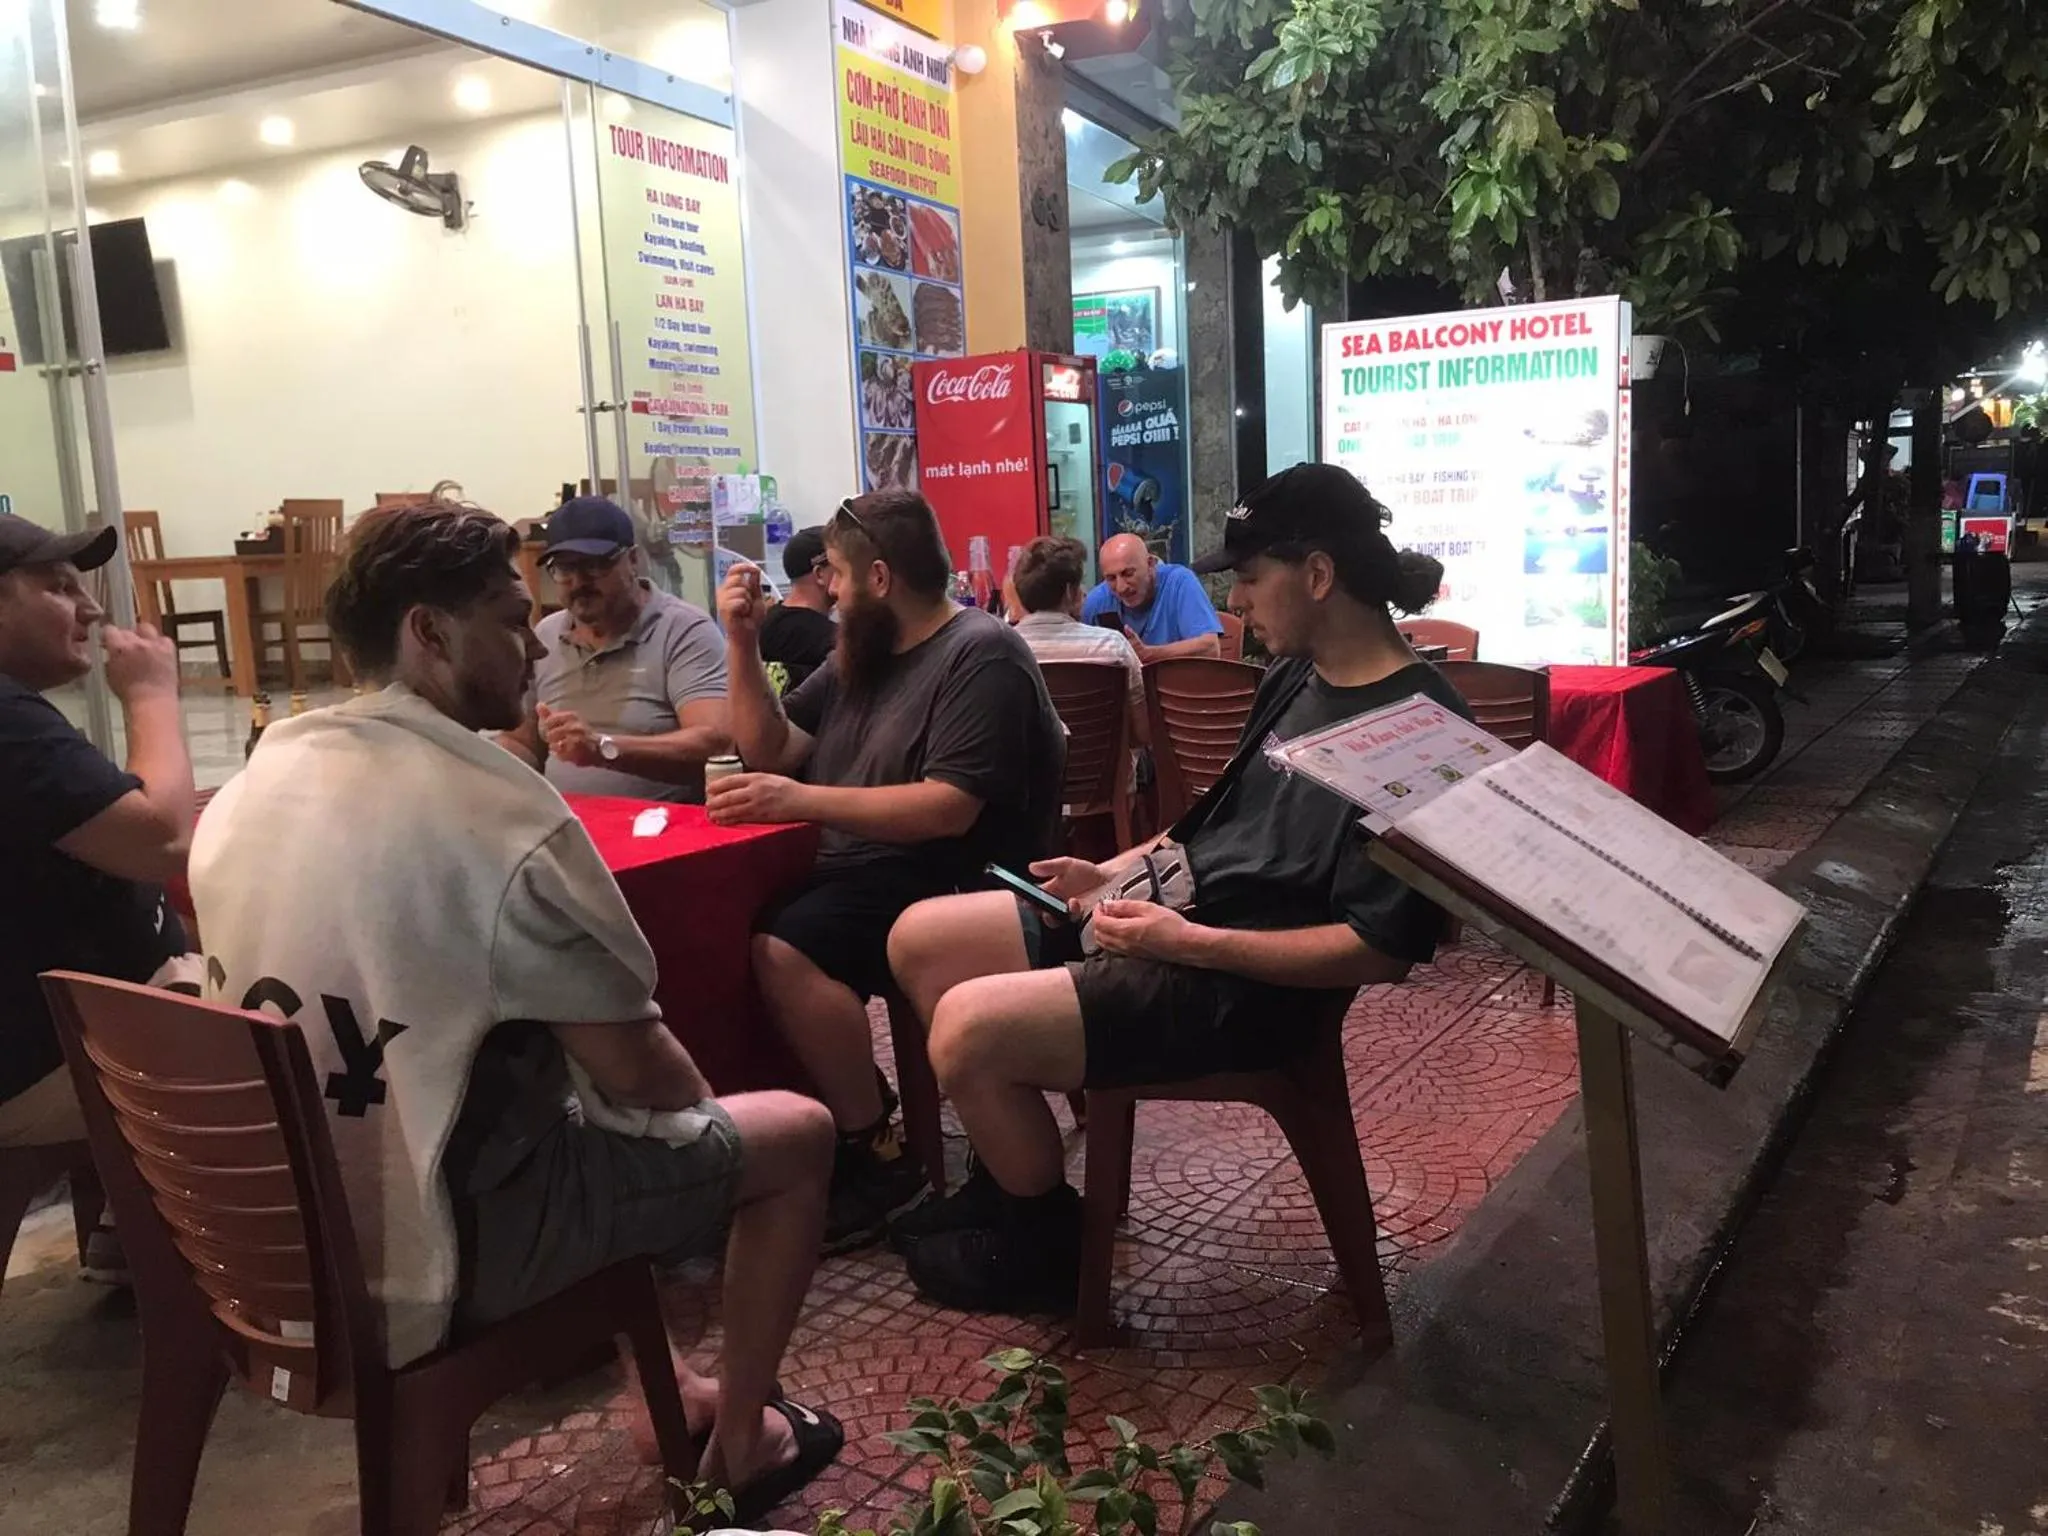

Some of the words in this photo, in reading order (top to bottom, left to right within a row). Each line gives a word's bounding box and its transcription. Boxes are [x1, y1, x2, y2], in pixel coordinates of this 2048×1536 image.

[903, 45, 924, 75] ANH
[609, 124, 645, 161] TOUR
[647, 135, 729, 184] INFORMATION
[869, 160, 907, 187] SEAFOOD
[908, 172, 938, 196] HOTPOT
[646, 188, 658, 203] HA
[660, 192, 684, 210] LONG
[686, 198, 701, 214] BAY
[656, 294, 673, 309] LAN
[675, 297, 687, 311] HA
[689, 298, 704, 313] BAY
[1342, 331, 1382, 358] SEA
[1389, 320, 1503, 353] BALCONY
[1510, 312, 1592, 341] HOTEL
[1342, 361, 1431, 396] TOURIST
[1438, 346, 1598, 388] INFORMATION
[927, 363, 1015, 404] Coca-Cola
[1135, 398, 1167, 414] pepsi
[1112, 432, 1141, 447] PEPSI
[925, 463, 955, 478] mát
[959, 460, 991, 479] lạnh
[1433, 470, 1468, 483] FISHING
[1413, 490, 1445, 505] BOAT
[1450, 487, 1479, 503] TRIP
[1417, 541, 1446, 557] NIGHT
[1448, 541, 1472, 556] BOAT
